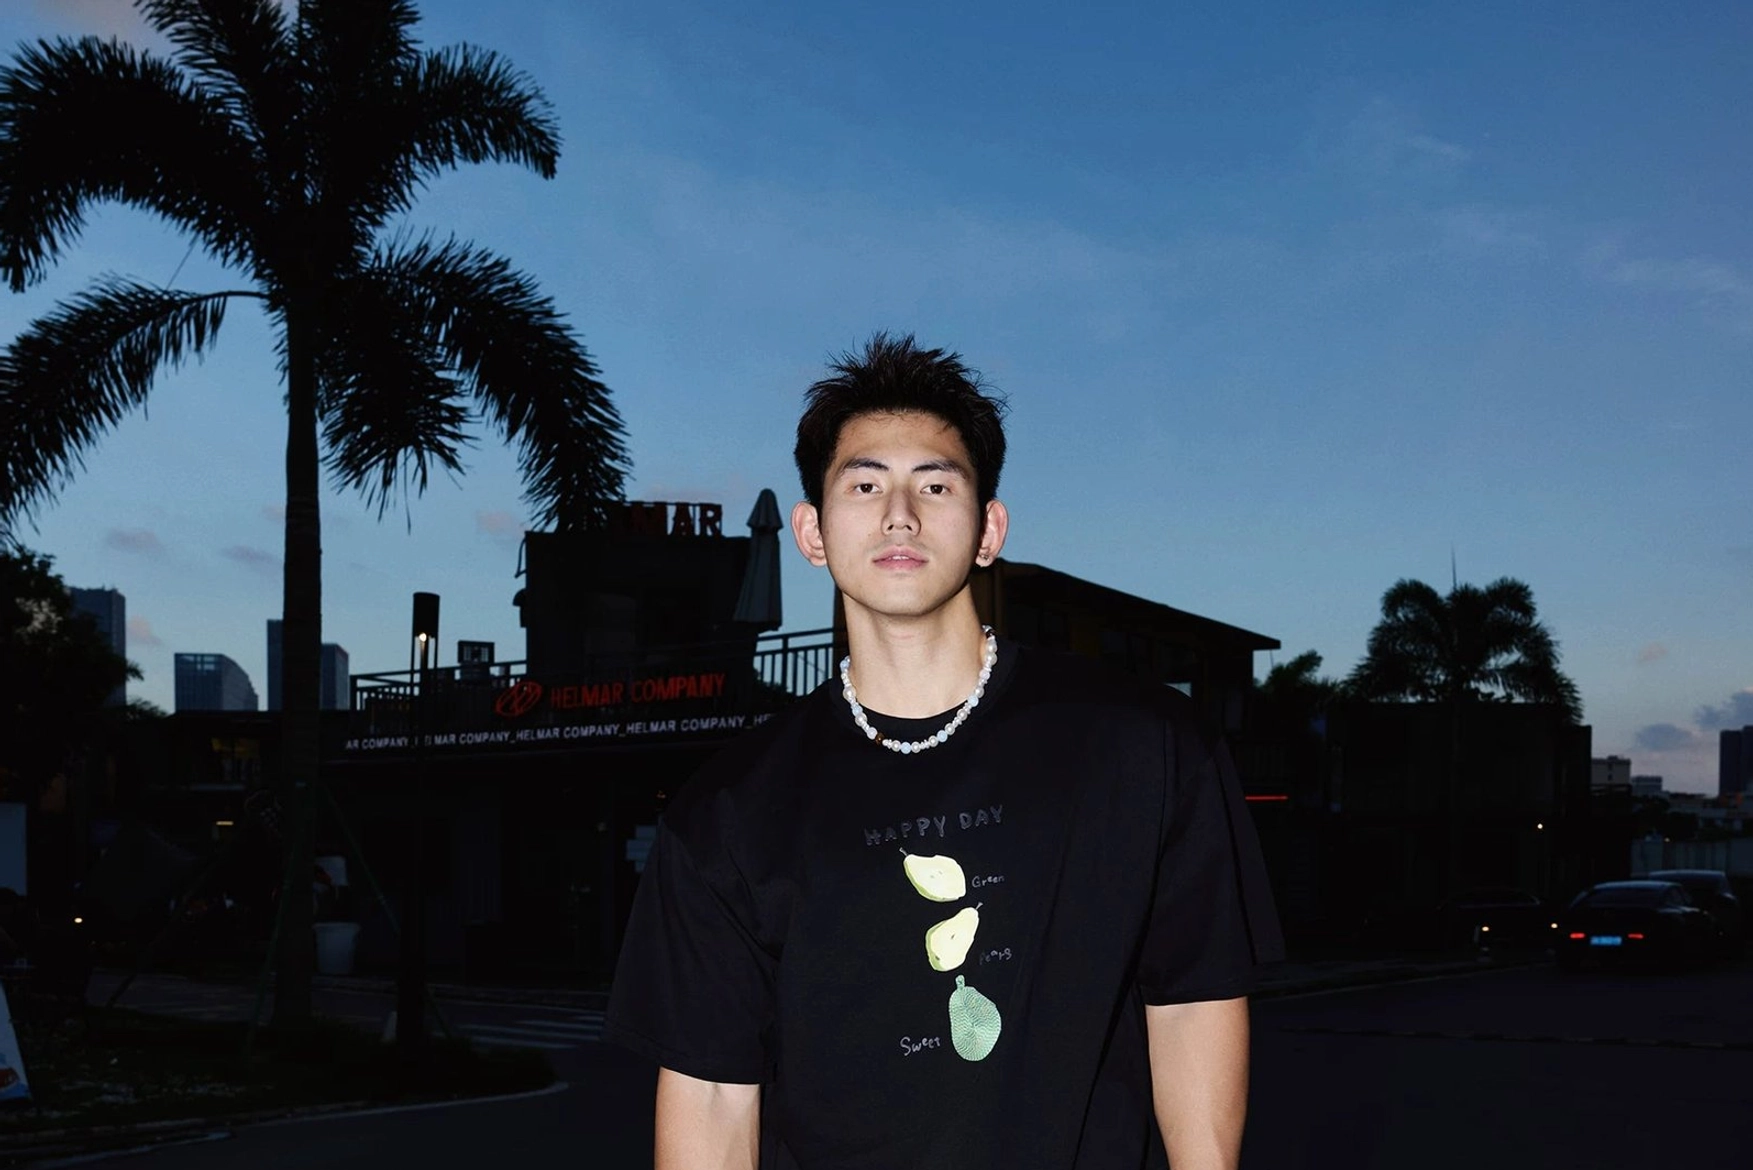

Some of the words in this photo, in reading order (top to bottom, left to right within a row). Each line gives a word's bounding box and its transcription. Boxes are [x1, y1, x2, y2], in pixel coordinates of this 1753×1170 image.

[549, 680, 626, 711] HELMAR
[630, 671, 728, 704] COMPANY
[863, 814, 947, 847] HAPPY
[957, 803, 1004, 831] DAY
[970, 874, 1006, 889] Green
[899, 1035, 942, 1057] Sweet
